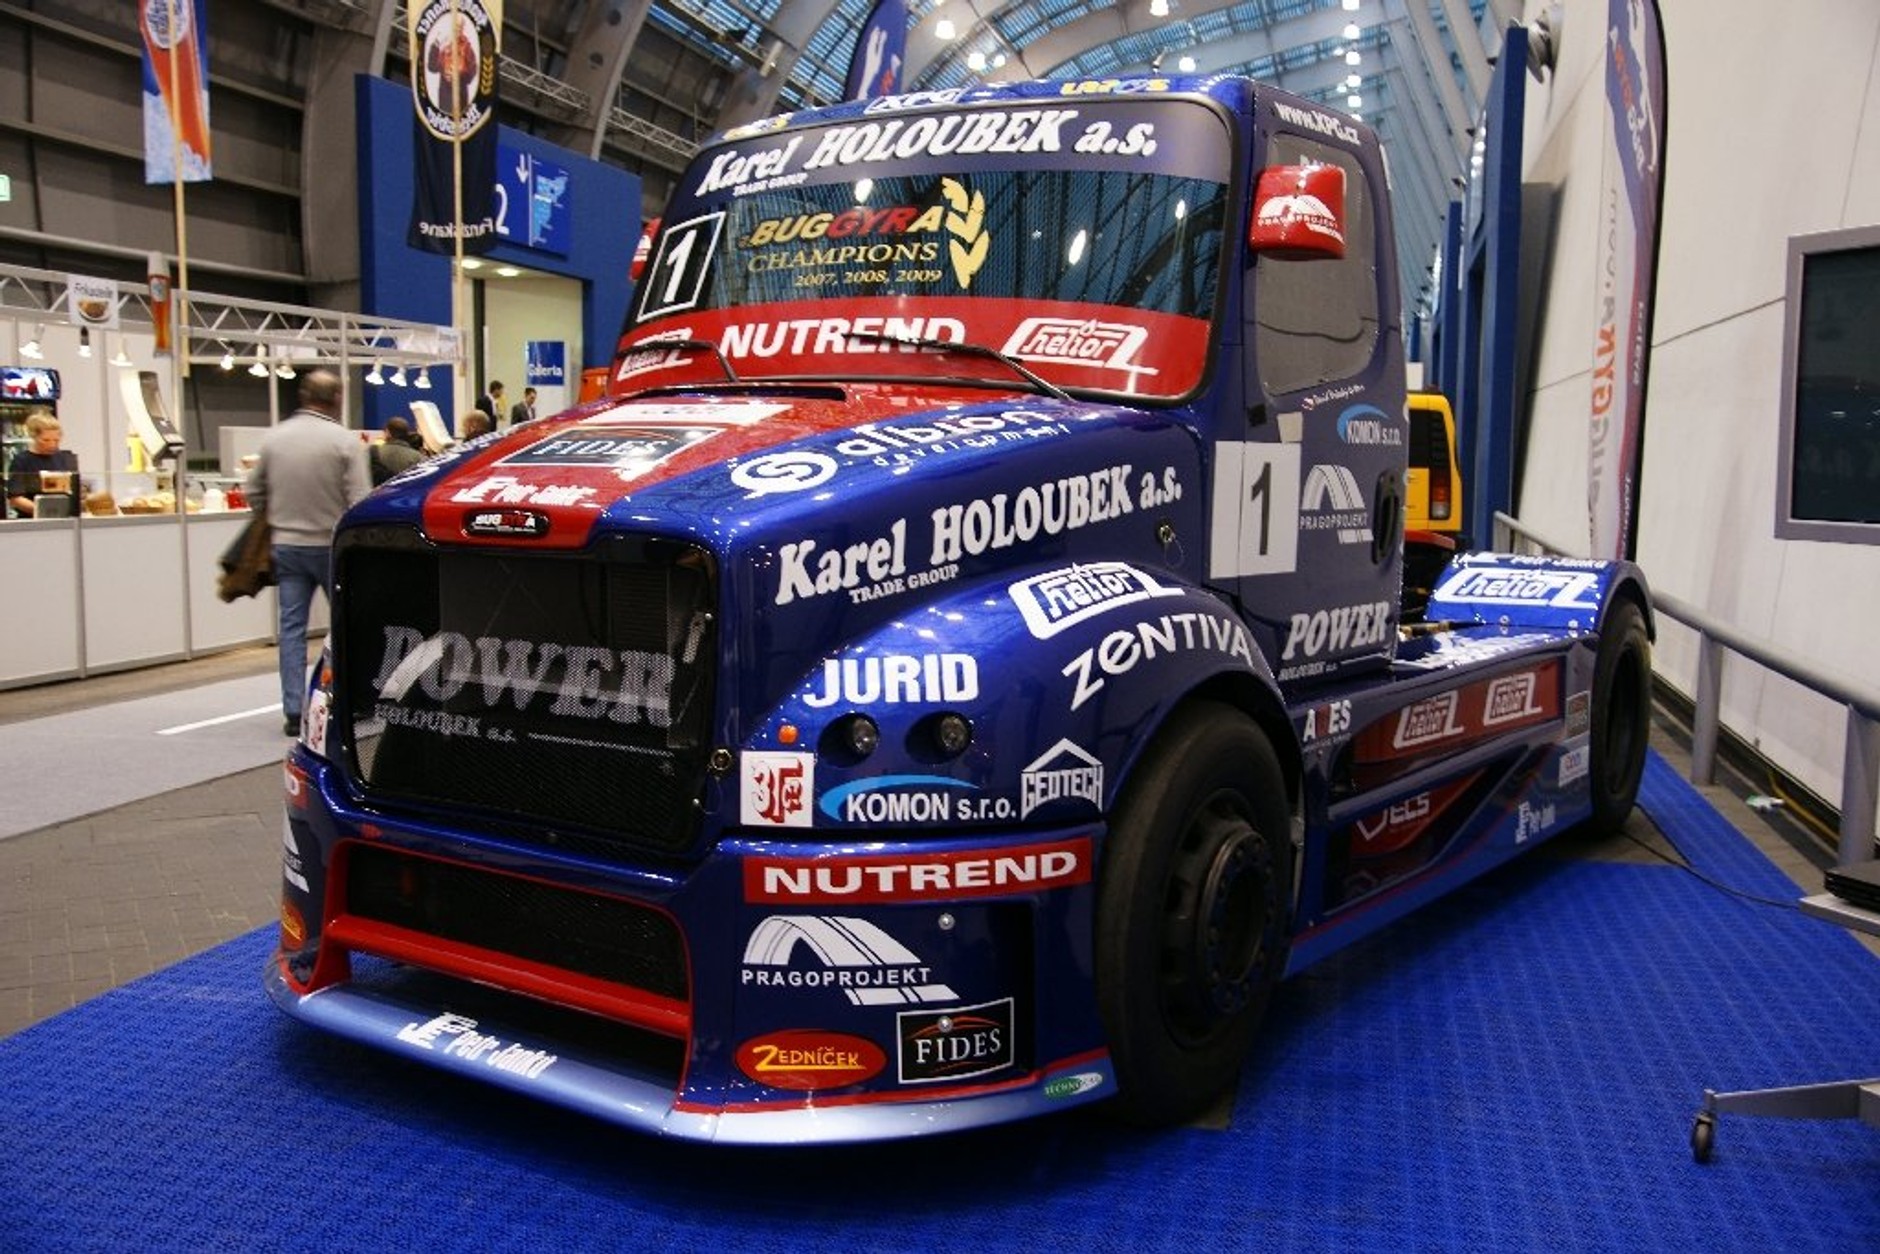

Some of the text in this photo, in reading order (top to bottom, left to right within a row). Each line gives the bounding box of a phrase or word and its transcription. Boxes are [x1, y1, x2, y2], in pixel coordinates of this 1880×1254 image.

[694, 136, 803, 198] Karel
[803, 110, 1078, 169] HOLOUBEK
[1075, 120, 1157, 156] a.s.
[751, 205, 946, 247] BUGGYRA
[665, 229, 698, 303] 1
[749, 242, 939, 273] CHAMPIONS
[794, 269, 943, 287] 2007, 2008, 2009
[720, 317, 965, 359] NUTREND
[1251, 461, 1271, 556] 1
[1299, 513, 1368, 530] PRAGOPROJEKT
[774, 464, 1183, 605] Karel HOLOUBEK a.s.
[850, 563, 960, 605] TRADE GROUP
[1281, 601, 1391, 661] POWER
[372, 625, 676, 728] POWER
[803, 653, 979, 708] JURID
[847, 791, 1017, 823] KOMON s.r.o.
[763, 850, 1078, 894] NUTREND
[741, 967, 931, 987] PRAGOPROJEKT
[915, 1029, 1001, 1064] FIDES
